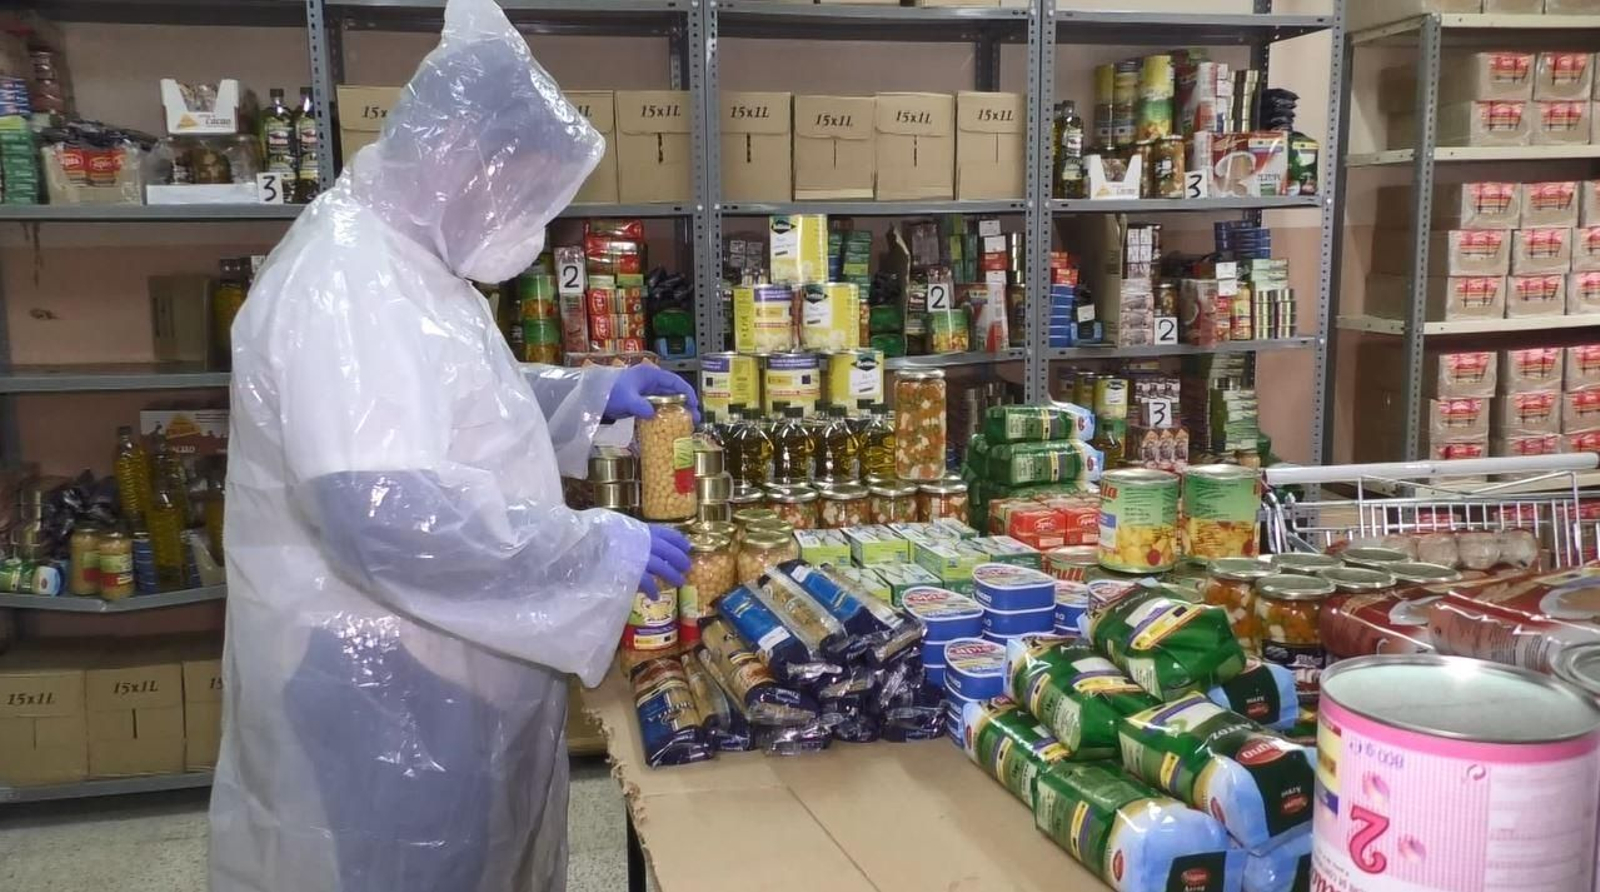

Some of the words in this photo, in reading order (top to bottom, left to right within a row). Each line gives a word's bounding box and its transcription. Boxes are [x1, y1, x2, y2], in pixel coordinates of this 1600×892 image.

[361, 105, 389, 120] 15x
[641, 104, 681, 118] 15x1L
[730, 106, 770, 119] 15x1L
[896, 110, 932, 125] 15x1L
[977, 109, 1014, 122] 15x1L
[816, 113, 855, 127] 15x1L
[262, 176, 277, 201] 3
[1188, 174, 1203, 198] 3
[562, 265, 580, 289] 2
[930, 285, 946, 309] 2
[1158, 319, 1175, 342] 2
[1152, 402, 1167, 425] 3
[113, 680, 159, 695] 15x1L
[8, 692, 54, 706] 15x1L
[1350, 804, 1390, 875] 2
